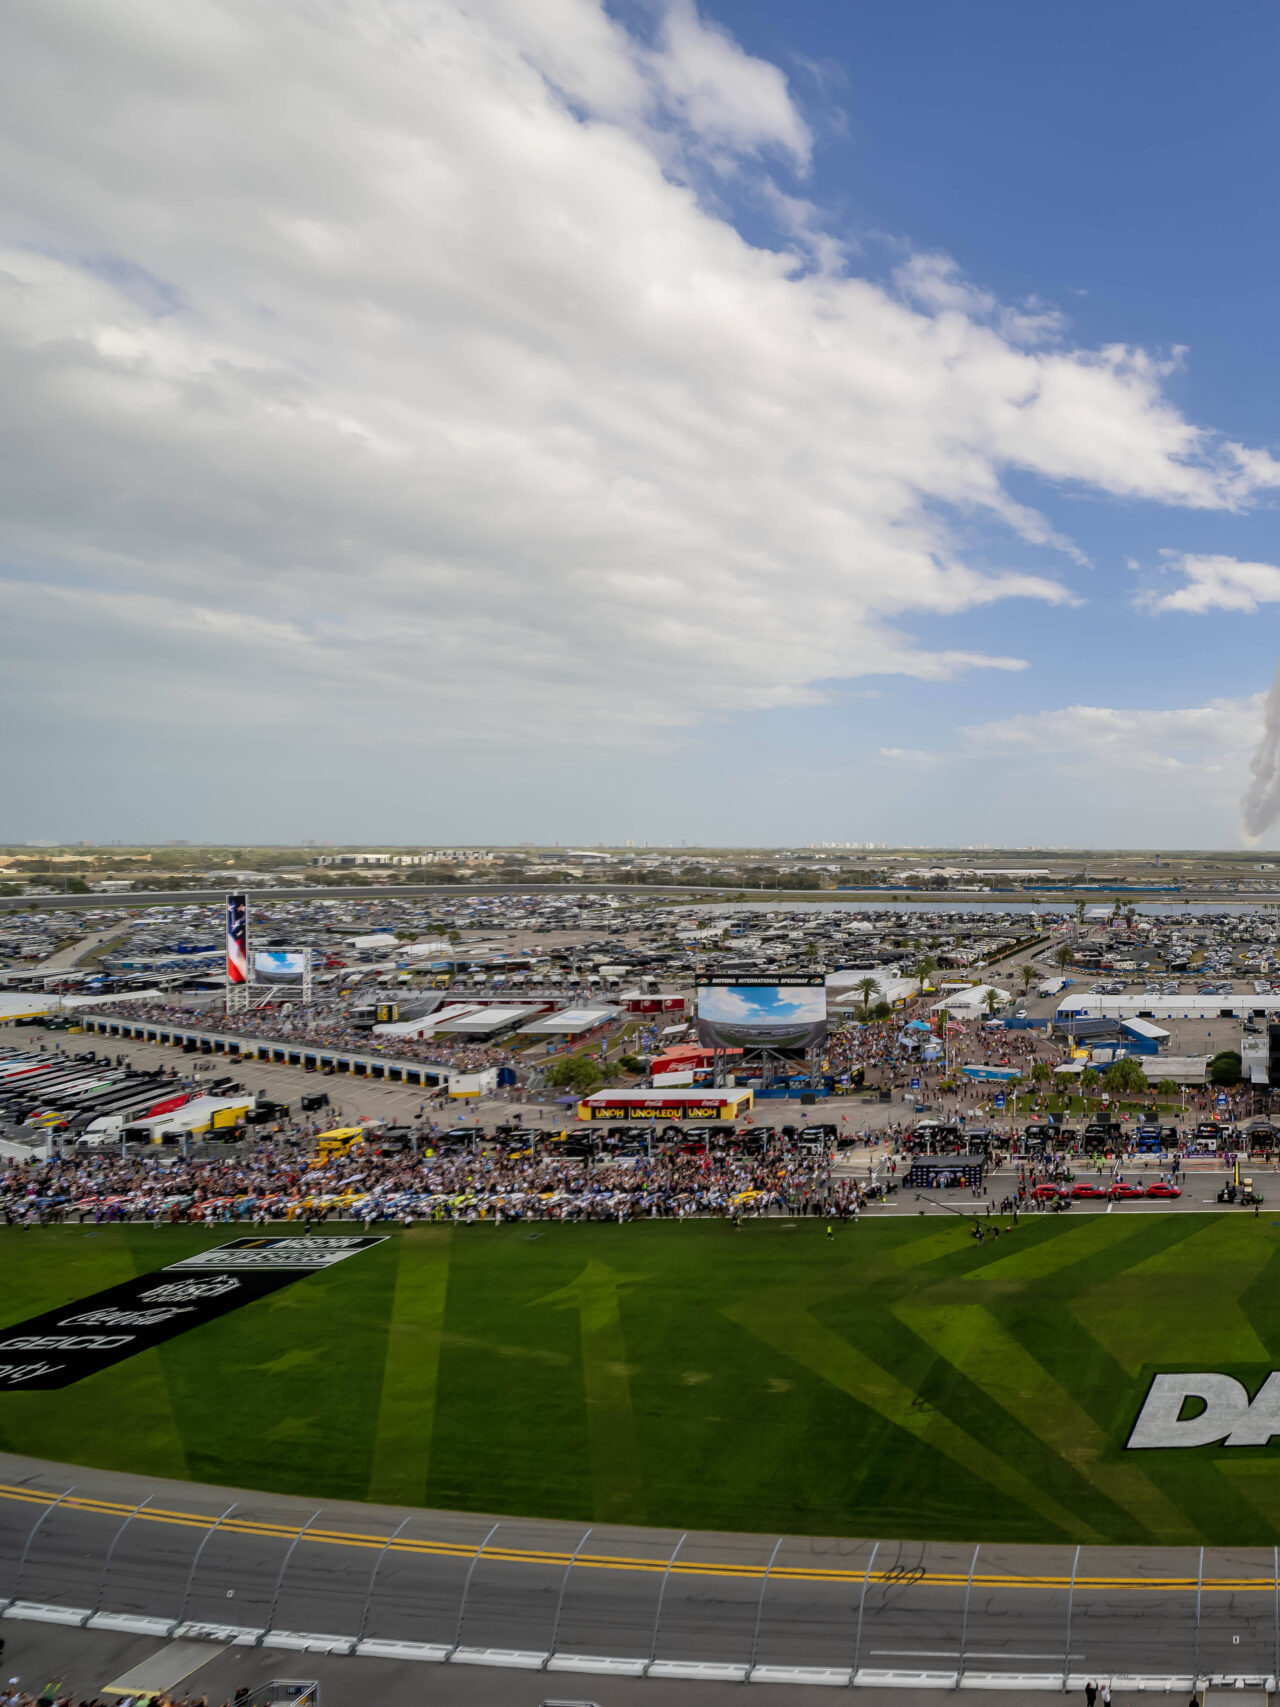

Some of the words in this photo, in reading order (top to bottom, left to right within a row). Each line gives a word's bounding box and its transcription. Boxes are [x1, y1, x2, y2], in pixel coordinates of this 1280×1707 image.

[595, 1108, 625, 1117] UNOH
[631, 1108, 681, 1117] UNOH.EDU
[688, 1108, 717, 1116] UNOH
[137, 1275, 242, 1299] BUSCH
[0, 1335, 137, 1350] GEICO
